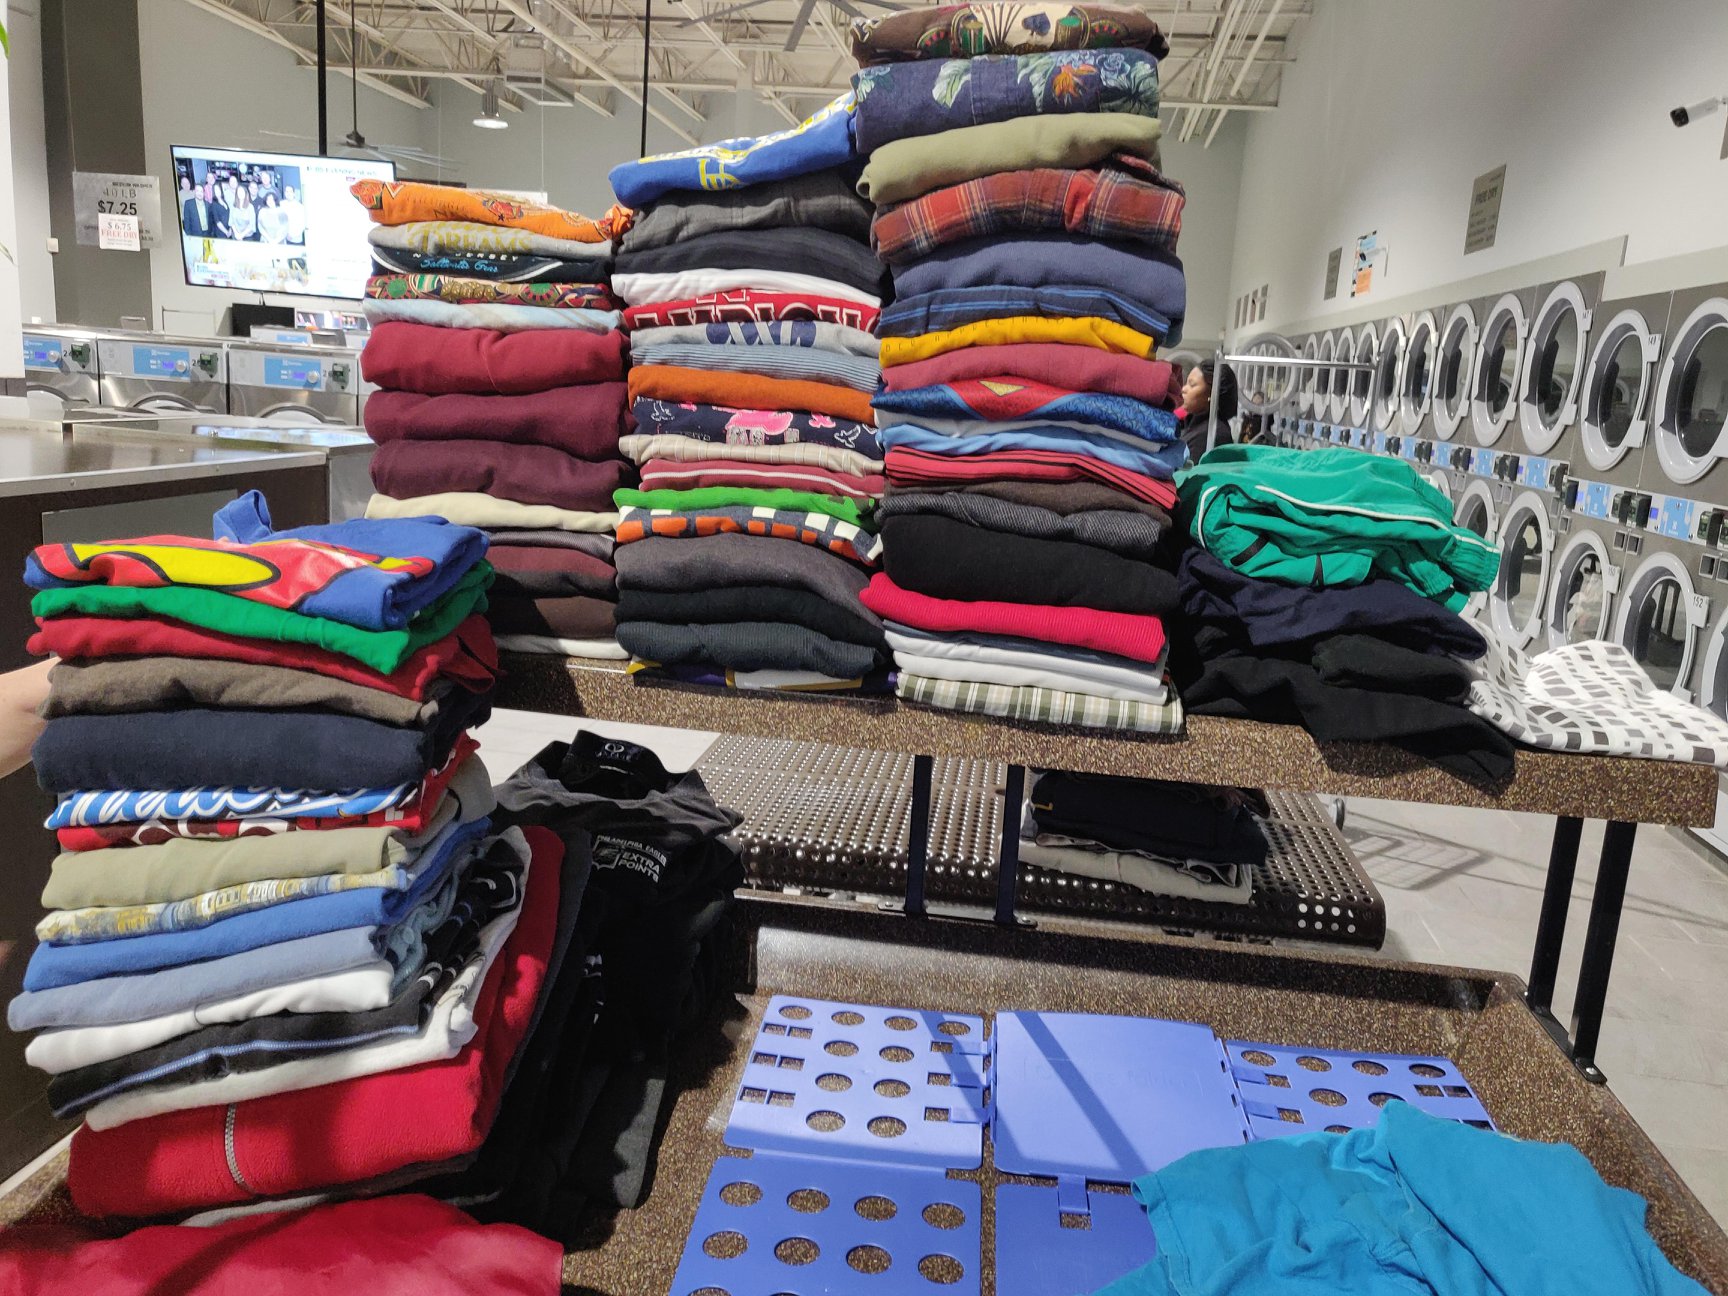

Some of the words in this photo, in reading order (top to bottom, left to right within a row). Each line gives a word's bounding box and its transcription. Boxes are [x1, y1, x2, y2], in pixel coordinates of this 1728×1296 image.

[97, 200, 137, 215] $7.25
[101, 229, 122, 238] FREE
[123, 230, 137, 239] DRY
[1693, 596, 1704, 609] 152
[622, 851, 660, 875] EXTRA
[618, 859, 659, 883] POINTS
